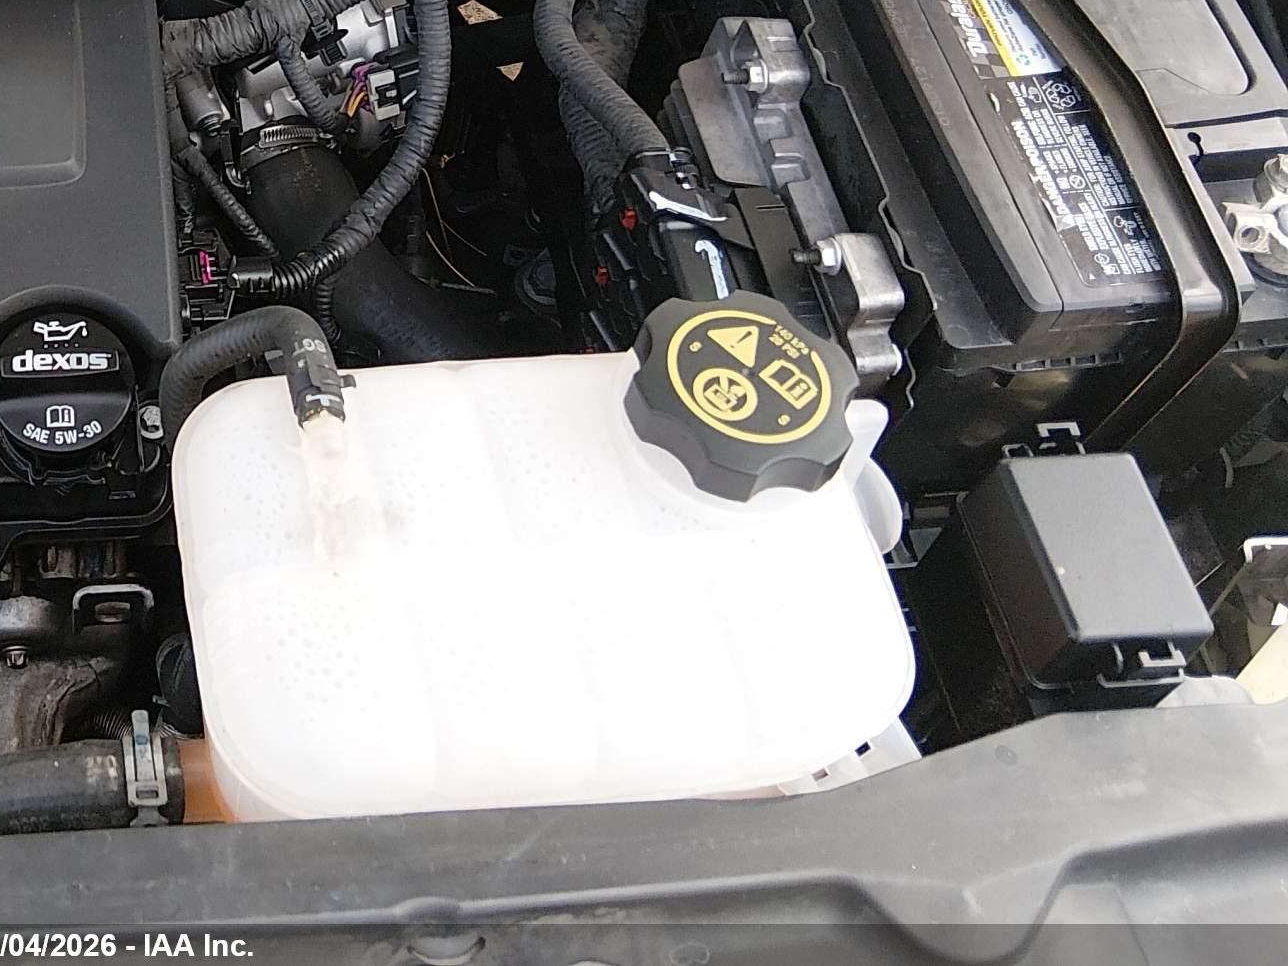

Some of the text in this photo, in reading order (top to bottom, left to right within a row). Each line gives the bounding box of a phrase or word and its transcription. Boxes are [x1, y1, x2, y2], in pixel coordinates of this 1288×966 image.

[12, 349, 109, 372] dexos
[23, 420, 103, 445] SAE 5W-30
